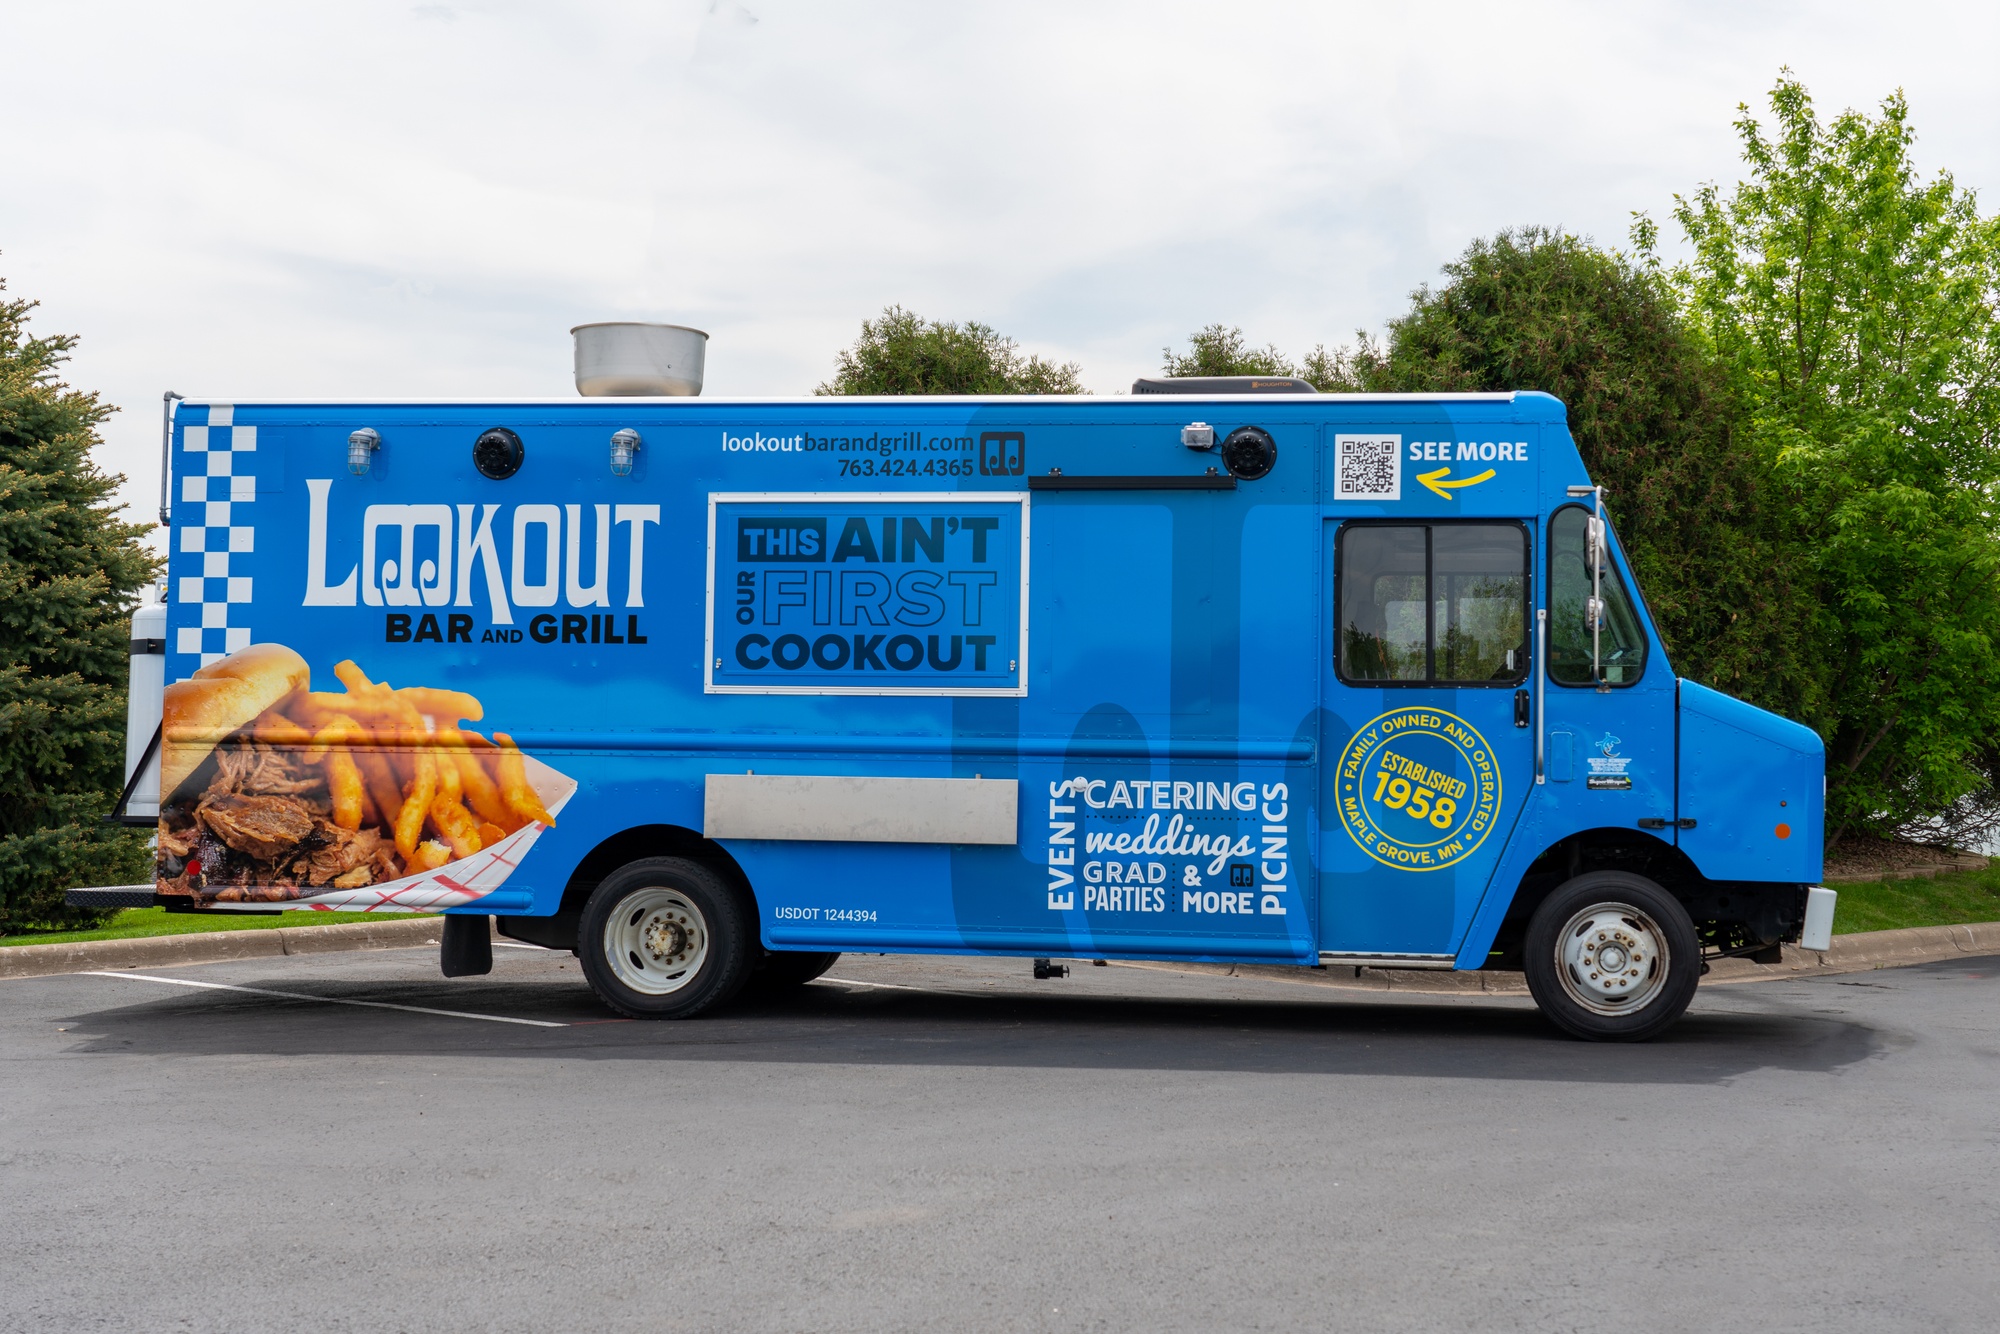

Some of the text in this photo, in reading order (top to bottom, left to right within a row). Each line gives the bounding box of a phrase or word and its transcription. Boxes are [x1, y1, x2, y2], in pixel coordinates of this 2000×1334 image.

[721, 432, 974, 456] lookoutbarandgrill.com
[1409, 441, 1529, 461] SEE MORE
[838, 459, 974, 477] 763.424.4365
[743, 516, 999, 563] THIS AIN'T
[736, 570, 998, 627] OUR FIRST
[385, 613, 648, 645] BAR AND GRILL
[735, 633, 997, 672] COOKOUT
[1344, 714, 1495, 832] FAMILY OWNED AND OPERATED
[1380, 750, 1468, 800] ESTABLISHED
[1084, 779, 1257, 811] CATERING
[1372, 771, 1458, 829] 1958
[1047, 779, 1076, 911] EVENTS
[1085, 813, 1256, 876] weddings
[1343, 797, 1464, 865] MAPLE GROVE, MN
[1260, 782, 1289, 916] PICNICS
[1083, 861, 1167, 884] GRAD
[1182, 864, 1203, 887] &
[775, 907, 878, 923] USDOT 1244394
[1084, 886, 1165, 912] PARTIES
[1182, 891, 1254, 914] MORE
